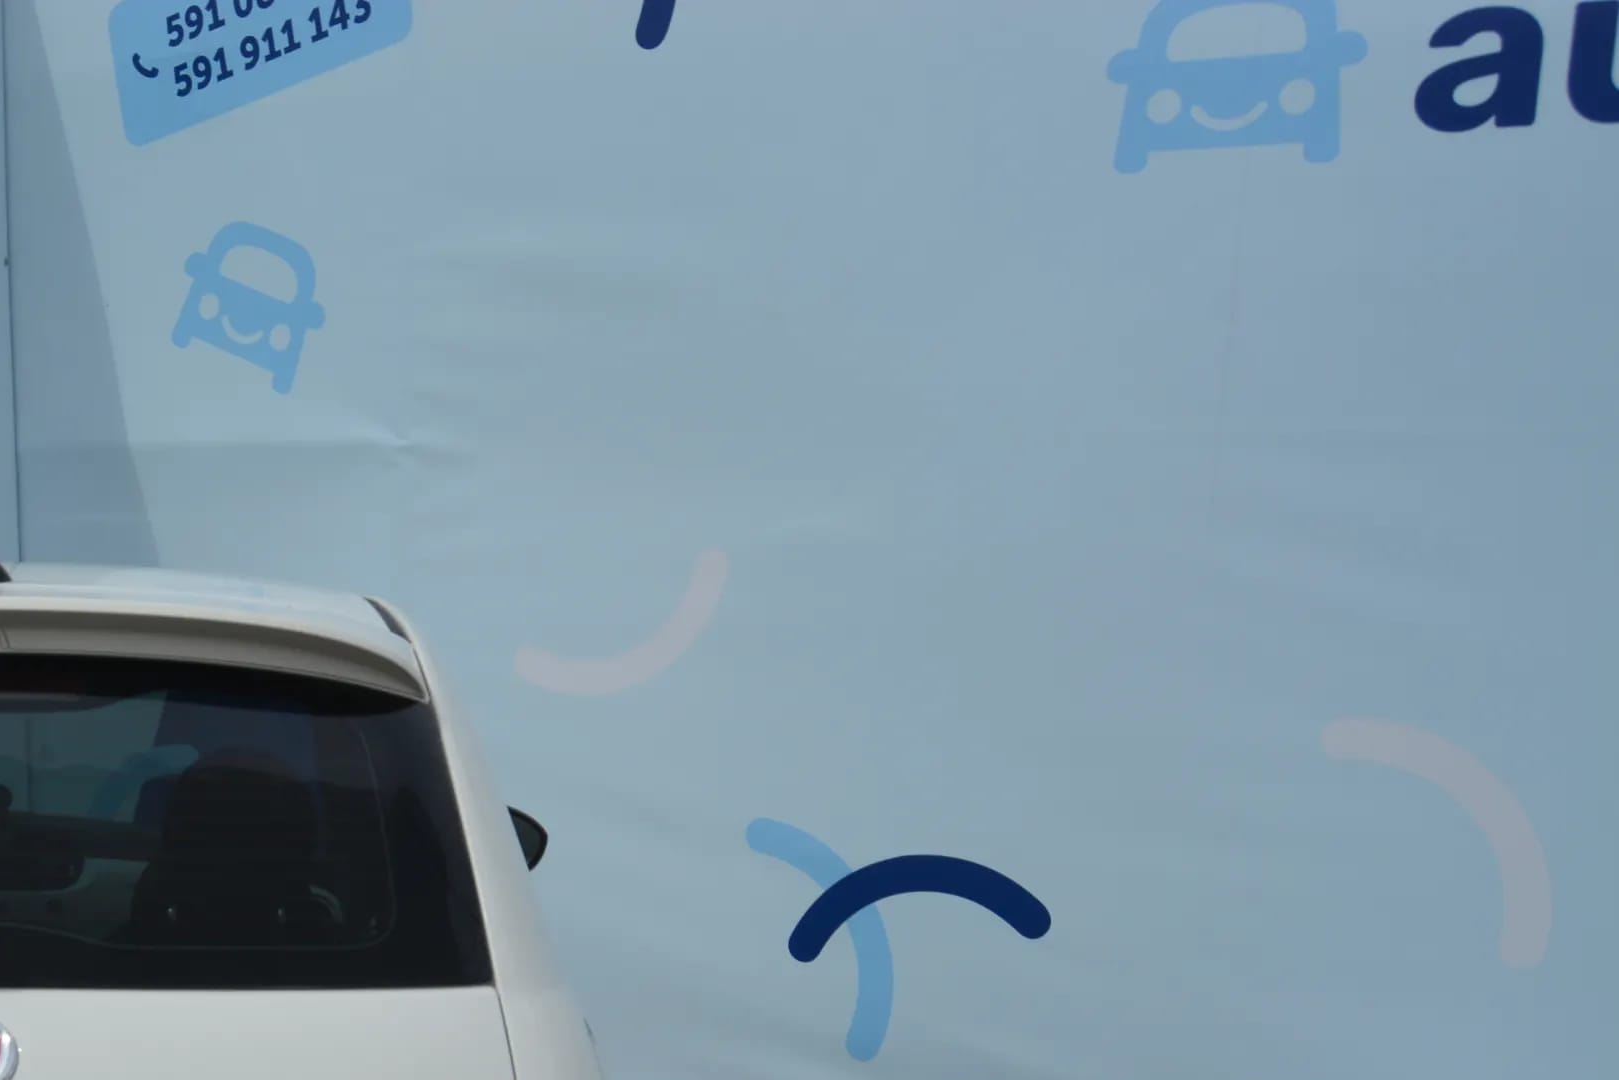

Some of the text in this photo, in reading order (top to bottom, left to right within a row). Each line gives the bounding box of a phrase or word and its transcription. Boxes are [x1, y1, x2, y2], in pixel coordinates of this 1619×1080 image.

[166, 0, 226, 48] 591
[173, 46, 234, 98] 591
[239, 18, 302, 71] 911
